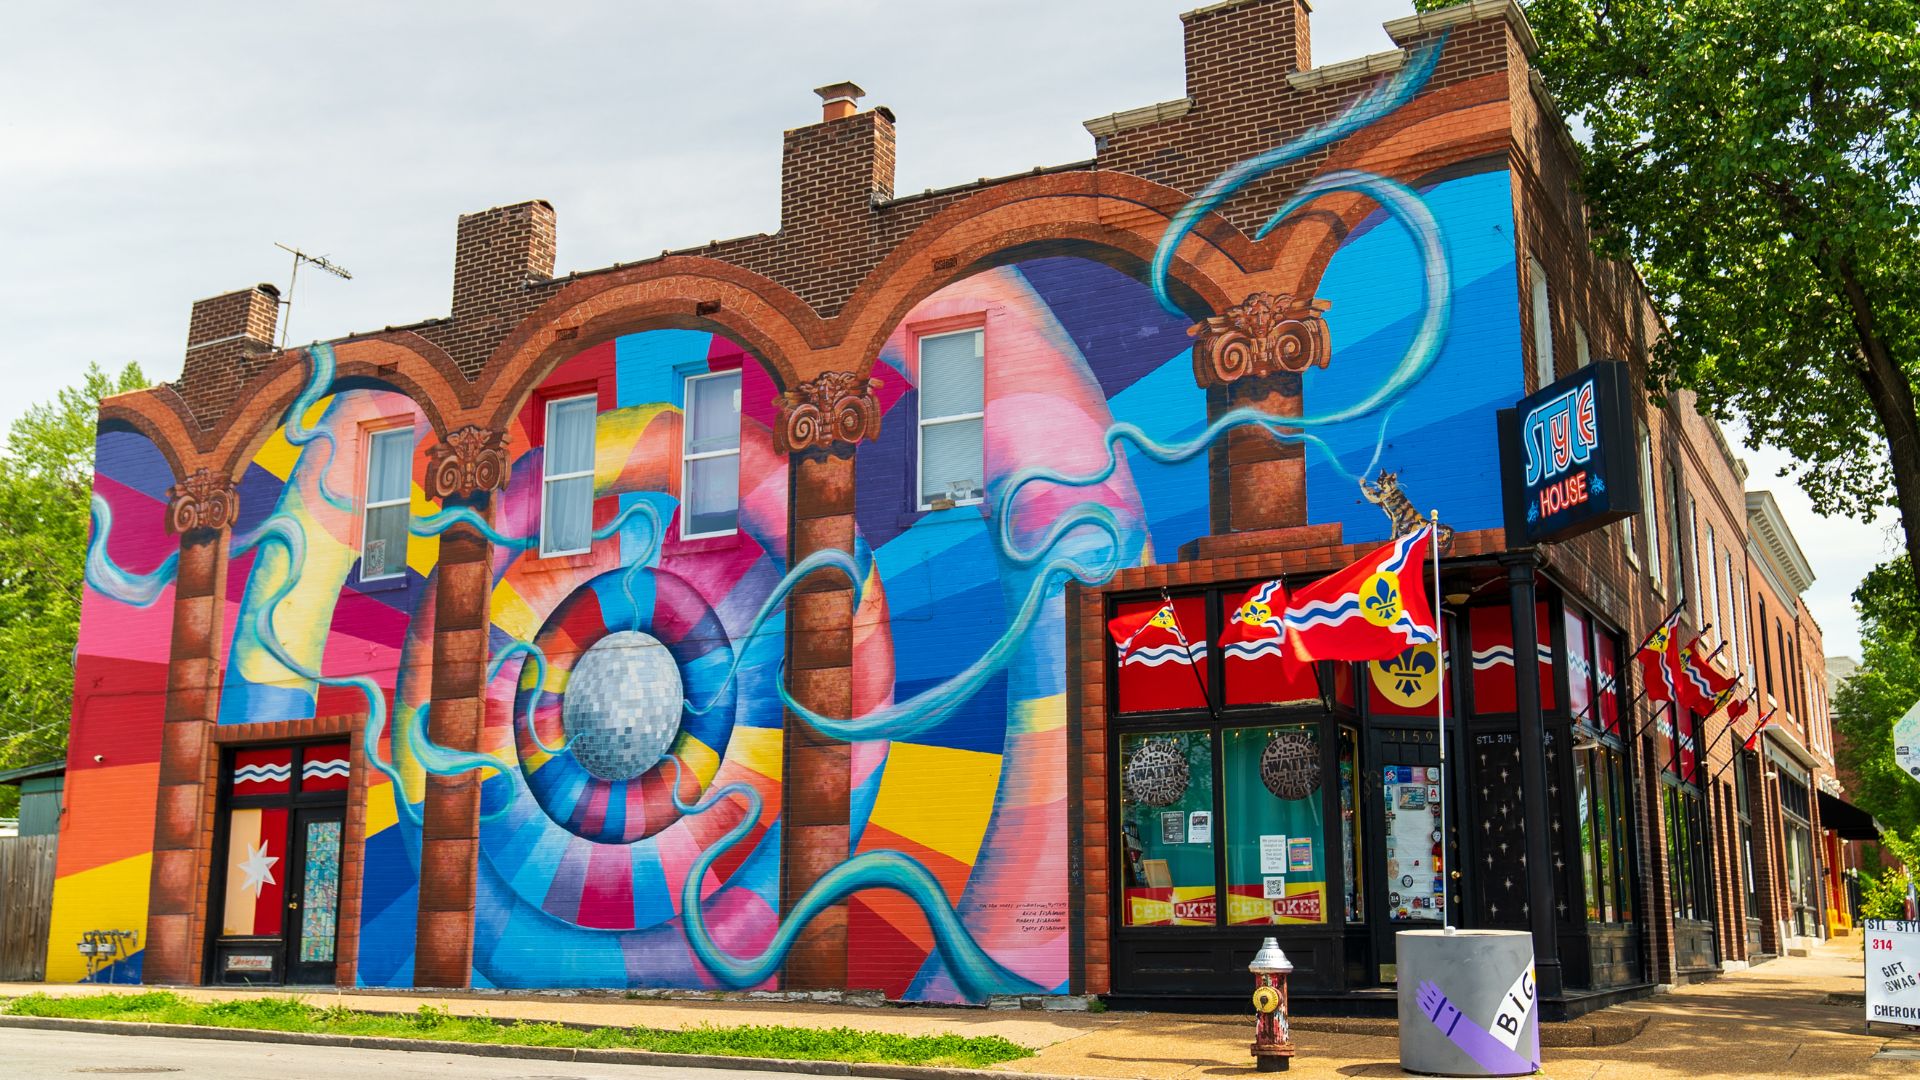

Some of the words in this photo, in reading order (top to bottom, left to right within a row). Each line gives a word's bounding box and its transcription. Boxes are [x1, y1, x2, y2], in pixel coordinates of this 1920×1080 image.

[523, 288, 625, 363] NOTHING
[633, 277, 767, 320] IMPOSSIBLE
[1540, 471, 1588, 519] HOUSE
[1476, 735, 1495, 745] STL
[1497, 733, 1513, 744] 314
[1133, 765, 1185, 782] WATER
[1229, 899, 1321, 917] CHEROKEE
[1868, 919, 1888, 931] STL
[1872, 939, 1893, 951] 314
[1881, 961, 1906, 978] GIFT
[1884, 974, 1916, 992] SWAG
